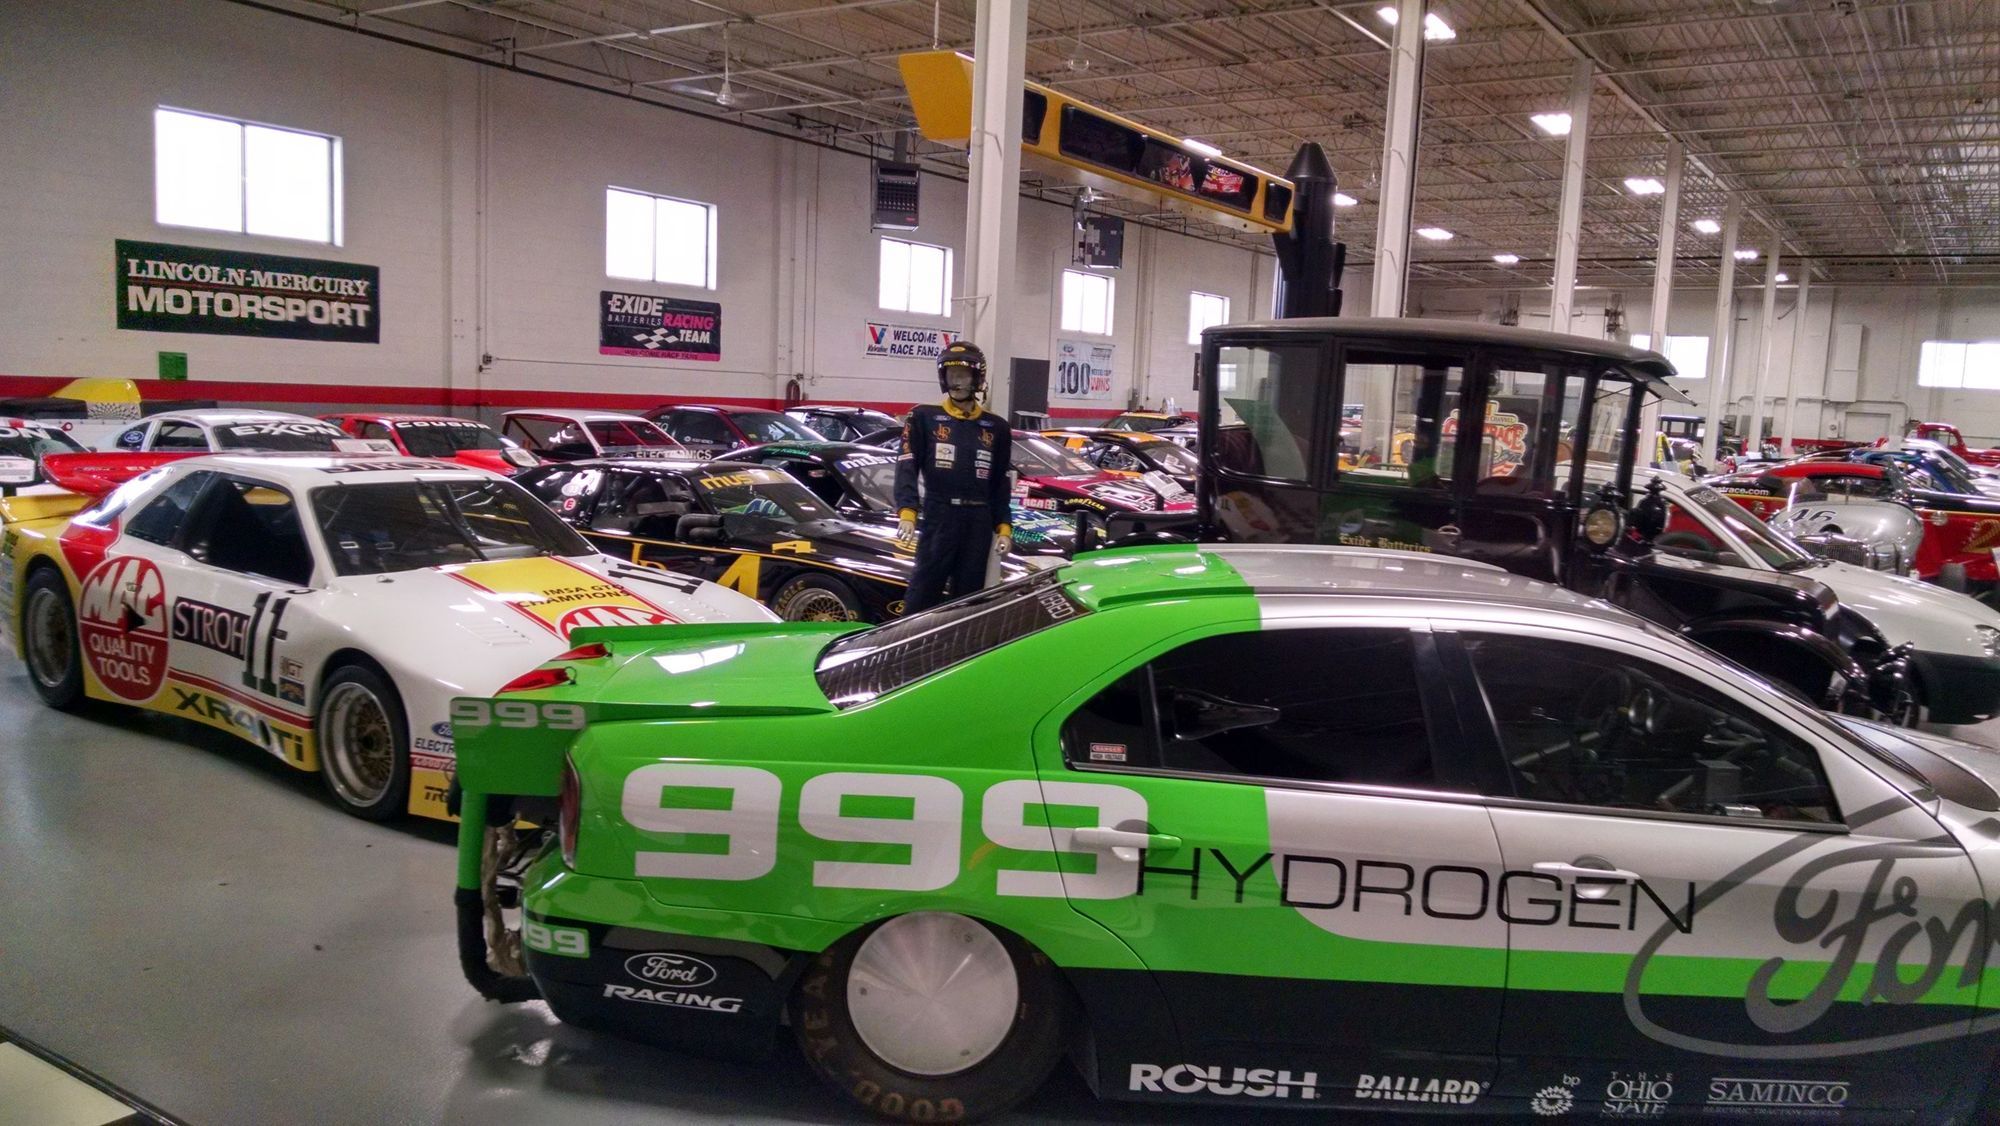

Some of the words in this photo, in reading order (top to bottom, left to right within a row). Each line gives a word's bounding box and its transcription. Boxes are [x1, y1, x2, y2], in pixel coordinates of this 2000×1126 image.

[128, 258, 369, 297] LINCOLN-MERCURY
[128, 286, 370, 328] MOTORSPORT
[609, 294, 664, 316] EXIDE
[608, 314, 661, 326] BATTERIES
[663, 313, 714, 330] RACING
[680, 330, 710, 344] TEAM
[894, 330, 938, 343] WELCOME
[890, 344, 914, 355] RACE
[917, 346, 939, 357] FANS
[1058, 361, 1091, 395] 100
[230, 423, 341, 437] EXXON
[635, 450, 712, 460] ELECTRONICS
[1786, 509, 1838, 523] 46
[1340, 533, 1371, 546] Exide
[1379, 537, 1432, 552] Batteries
[543, 585, 584, 596] IMSA
[174, 601, 249, 656] STROH
[90, 633, 155, 664] QUALITY
[97, 657, 151, 686] TOOLS
[451, 700, 586, 730] 999
[621, 764, 1149, 900] 999
[1136, 846, 1695, 935] HYDROGEN
[642, 956, 698, 982] Ford
[603, 984, 744, 1013] RACING
[1128, 1063, 1318, 1099] ROUSH
[1354, 1074, 1481, 1105] BALLARD
[1562, 1074, 1582, 1088] bp
[1607, 1080, 1673, 1101] OHIO
[1708, 1081, 1848, 1104] SAMINCO
